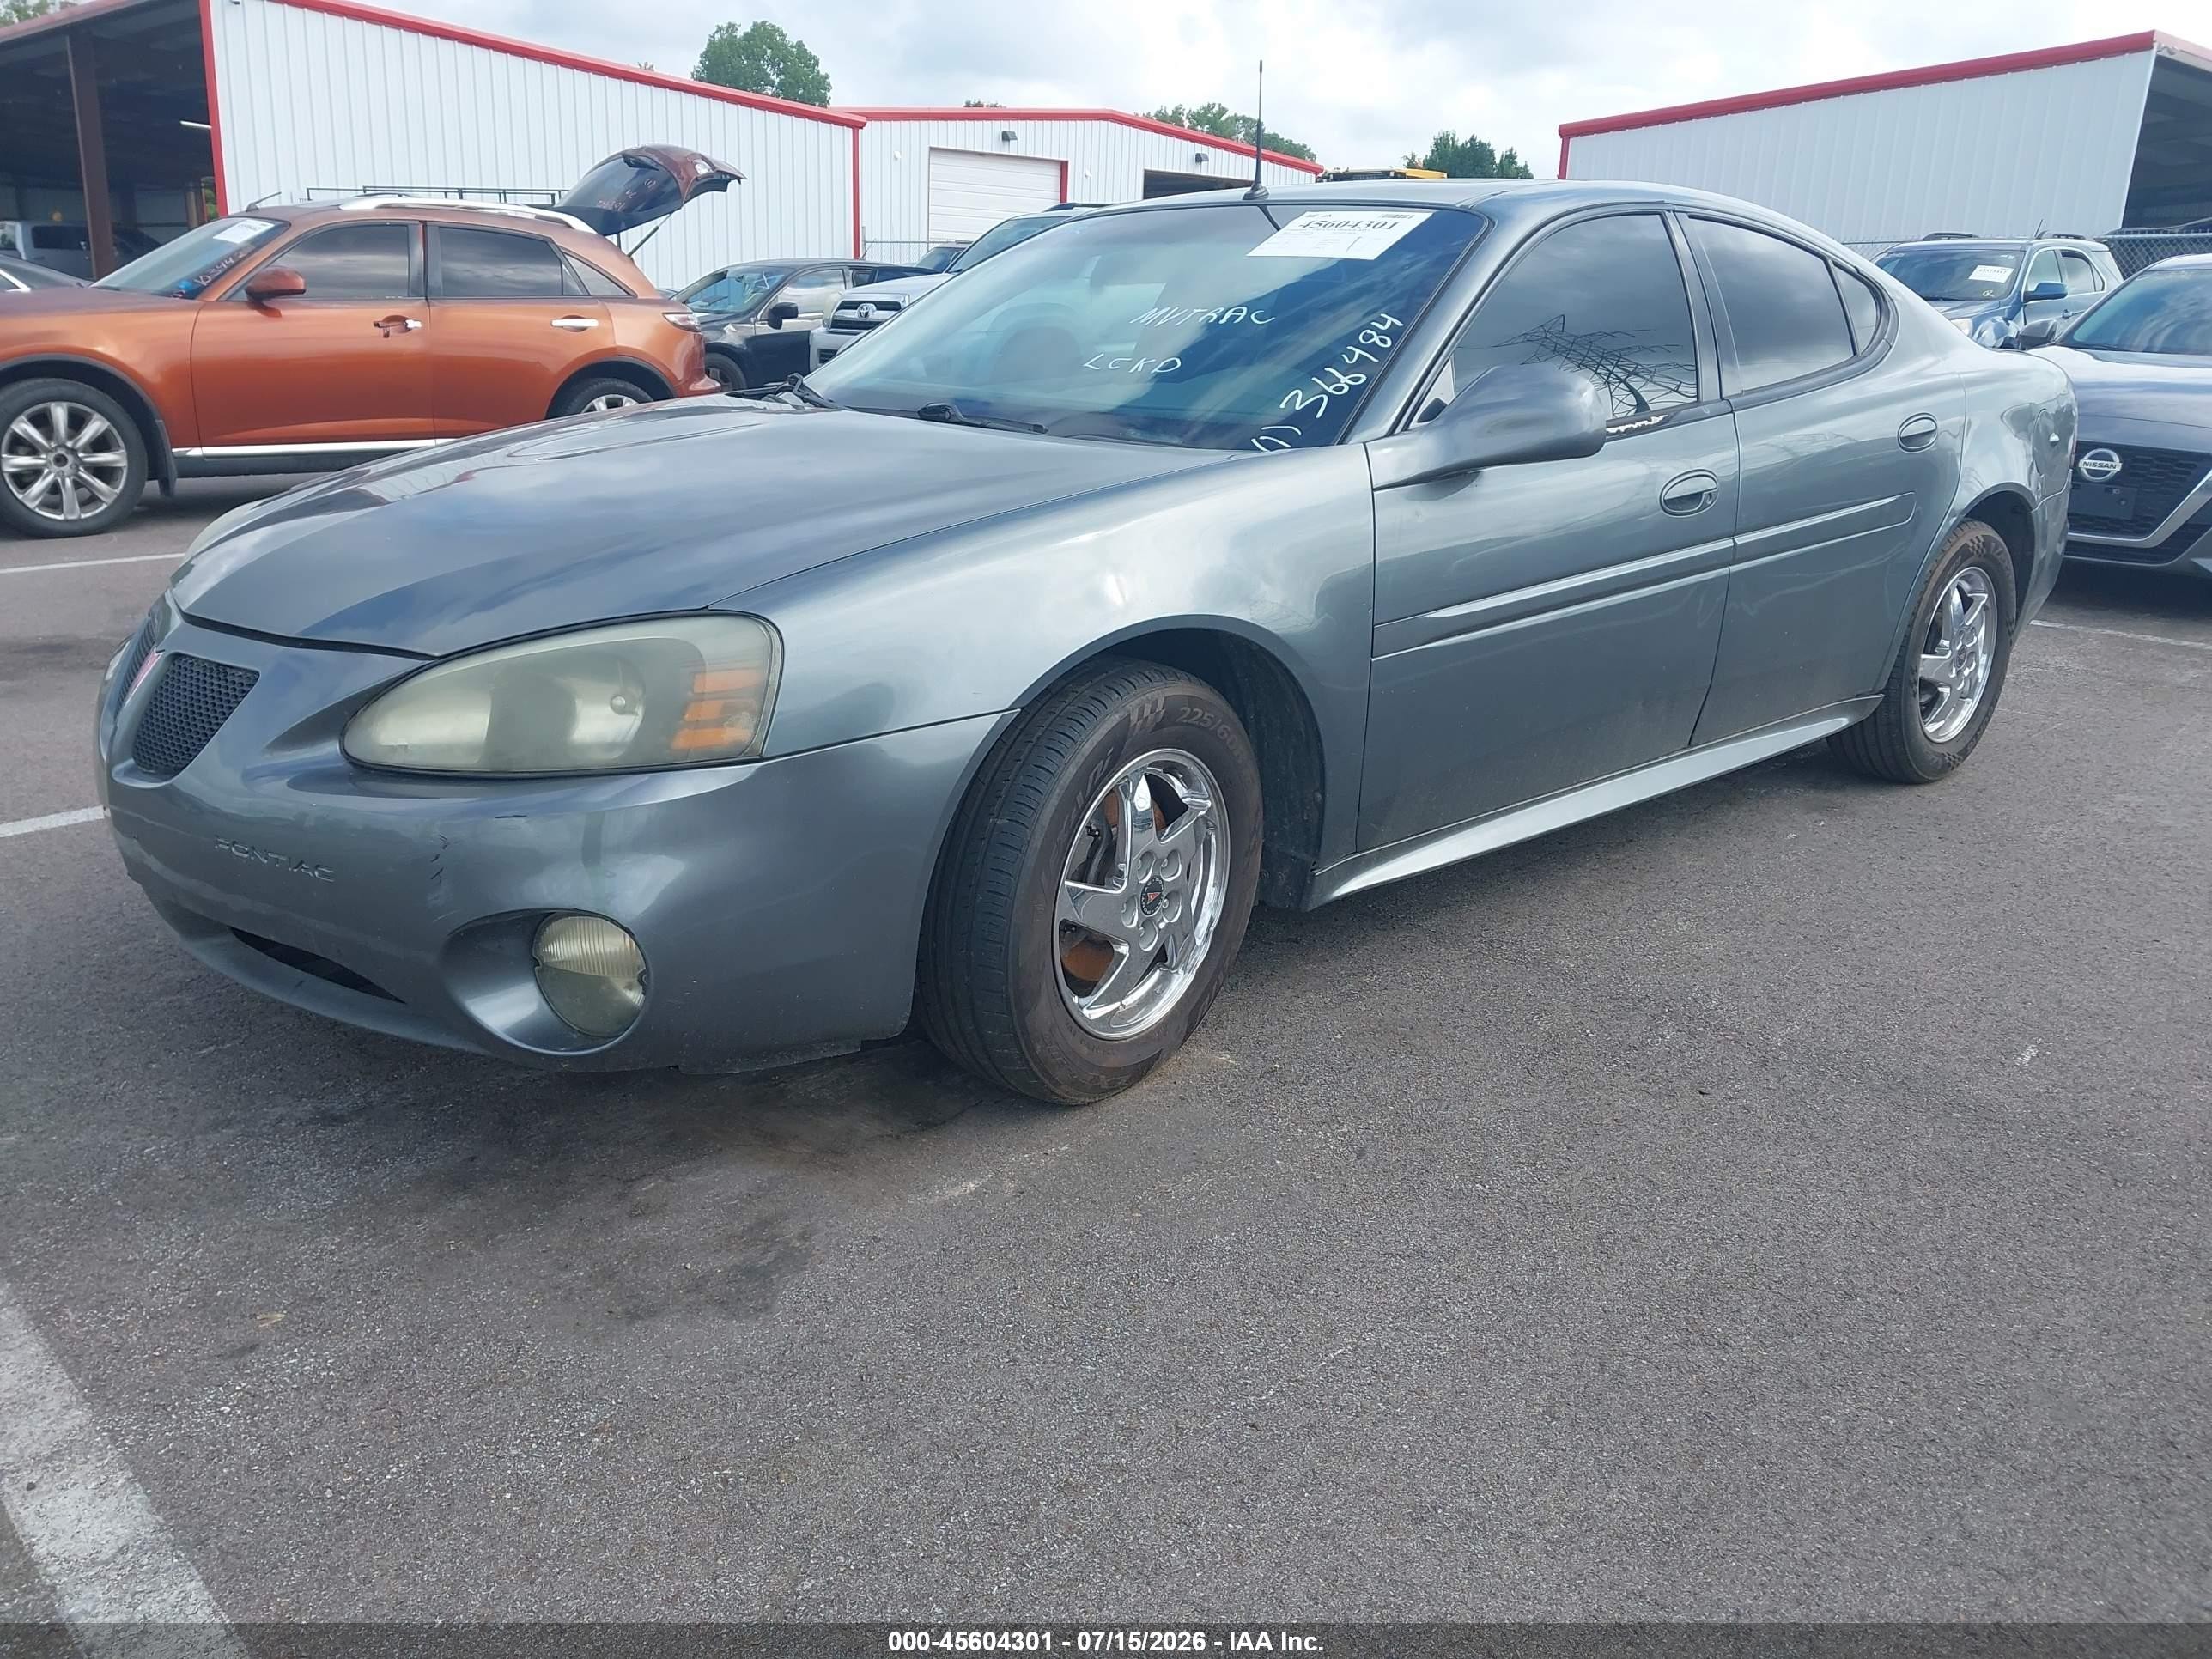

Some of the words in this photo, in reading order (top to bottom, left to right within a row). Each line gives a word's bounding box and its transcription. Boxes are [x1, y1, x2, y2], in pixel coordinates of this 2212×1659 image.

[1298, 220, 1400, 230] 45604301
[1279, 313, 1404, 419] 366484
[2082, 460, 2118, 470] NISSAN
[214, 836, 335, 882] PONTIAC
